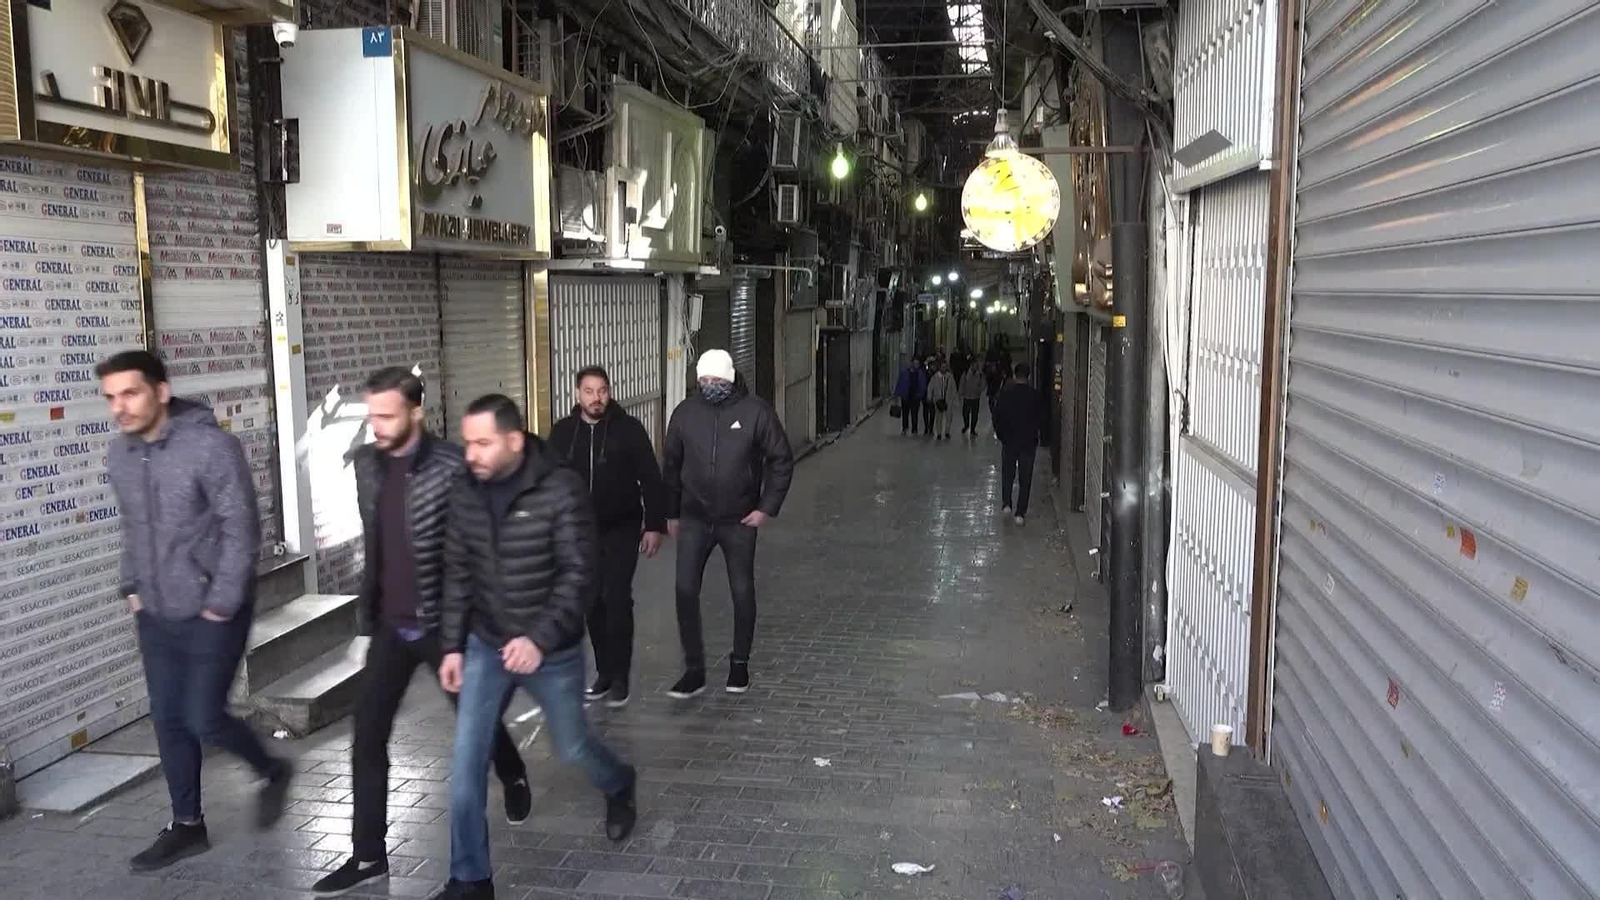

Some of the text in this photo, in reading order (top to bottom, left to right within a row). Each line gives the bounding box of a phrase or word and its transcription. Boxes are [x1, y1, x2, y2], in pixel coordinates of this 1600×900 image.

[370, 31, 385, 43] ۸۳
[77, 169, 111, 185] GENERAL
[64, 187, 98, 201] GENERAL
[41, 204, 78, 218] GENERAL
[468, 219, 530, 245] JEWELLERY
[81, 245, 115, 258] GENERAL
[36, 262, 73, 274] GENERAL
[2, 278, 119, 293] GENERAL GENERAL
[45, 299, 81, 311] GENERAL
[75, 317, 110, 328] GENERAL
[62, 335, 97, 346] GENERAL
[60, 353, 95, 365] GENERAL
[55, 370, 91, 383] GENERAL
[34, 389, 71, 403] GENERAL
[75, 421, 110, 436] GENERAL
[54, 442, 90, 457] GENERAL
[20, 464, 60, 481] GENERAL
[40, 498, 77, 515] GENERAL
